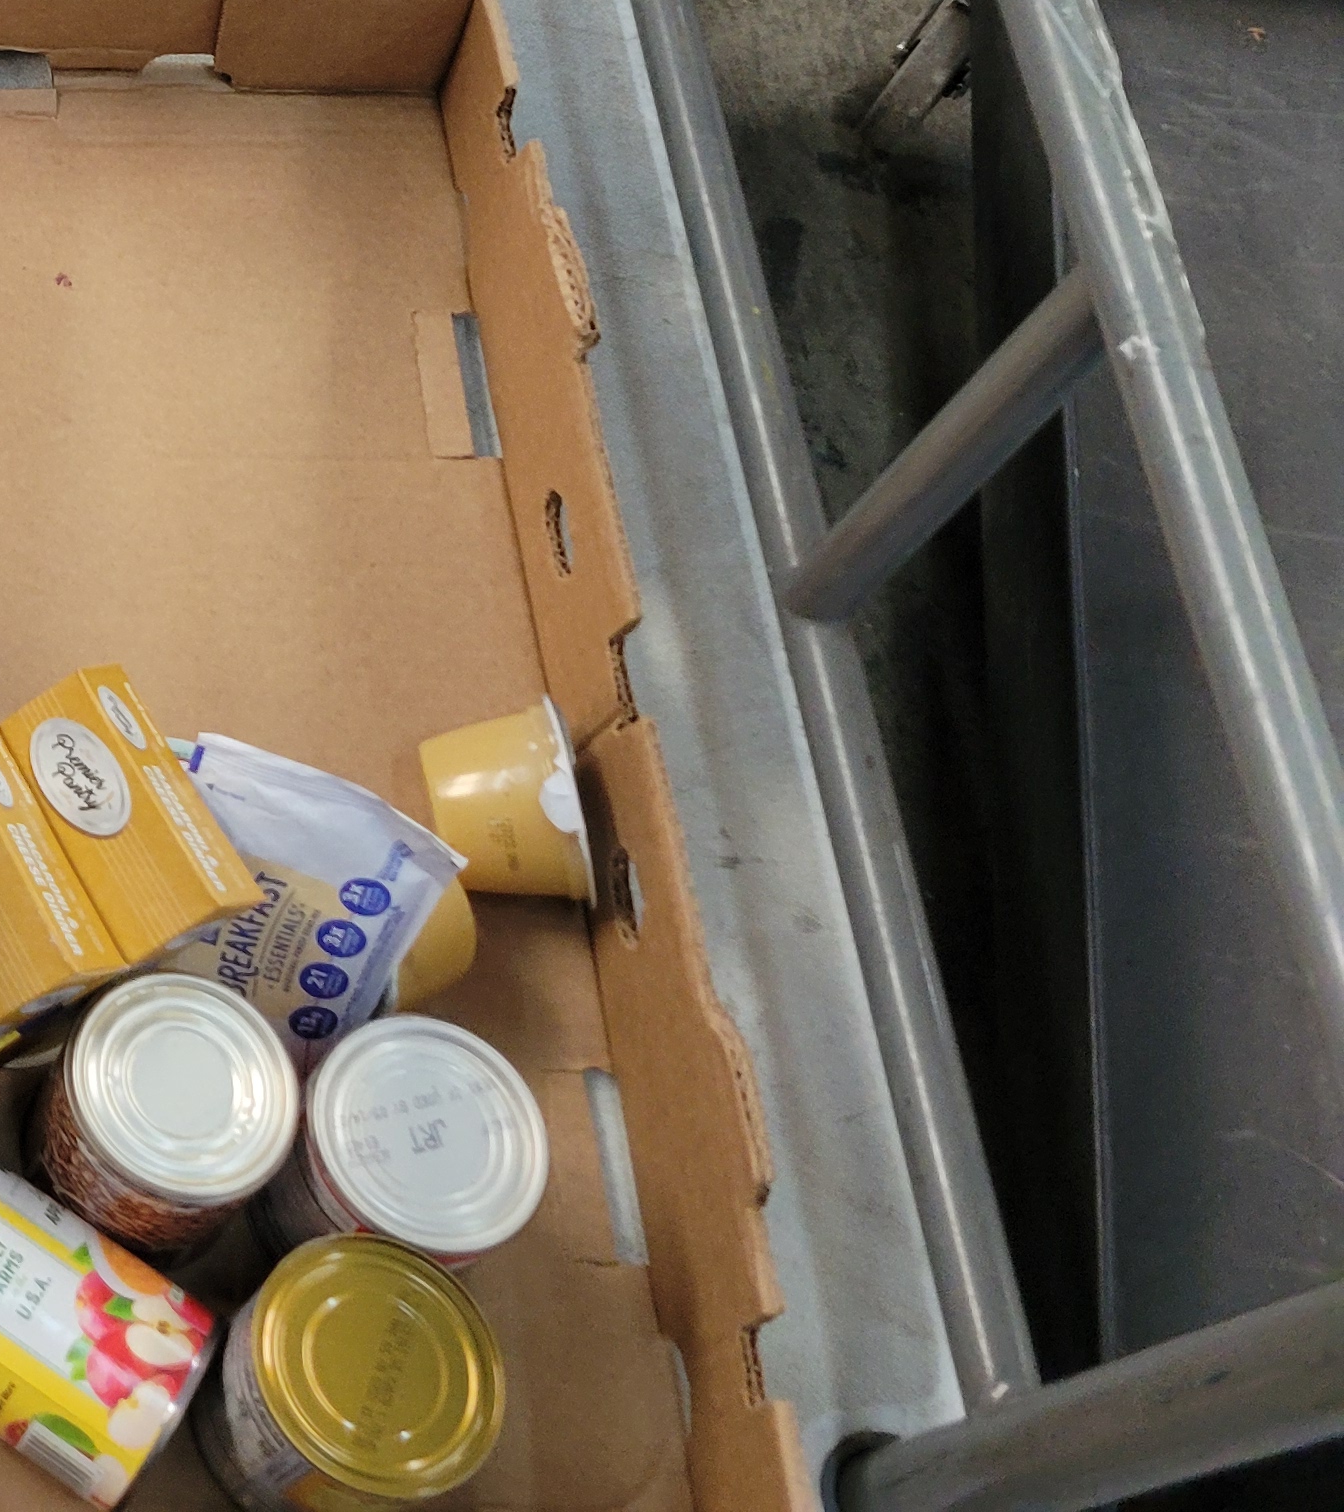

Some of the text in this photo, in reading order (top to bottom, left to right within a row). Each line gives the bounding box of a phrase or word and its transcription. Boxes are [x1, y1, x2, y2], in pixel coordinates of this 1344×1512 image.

[51, 733, 108, 812] Premier Pantry
[7, 822, 84, 958] CHEESE DINNER
